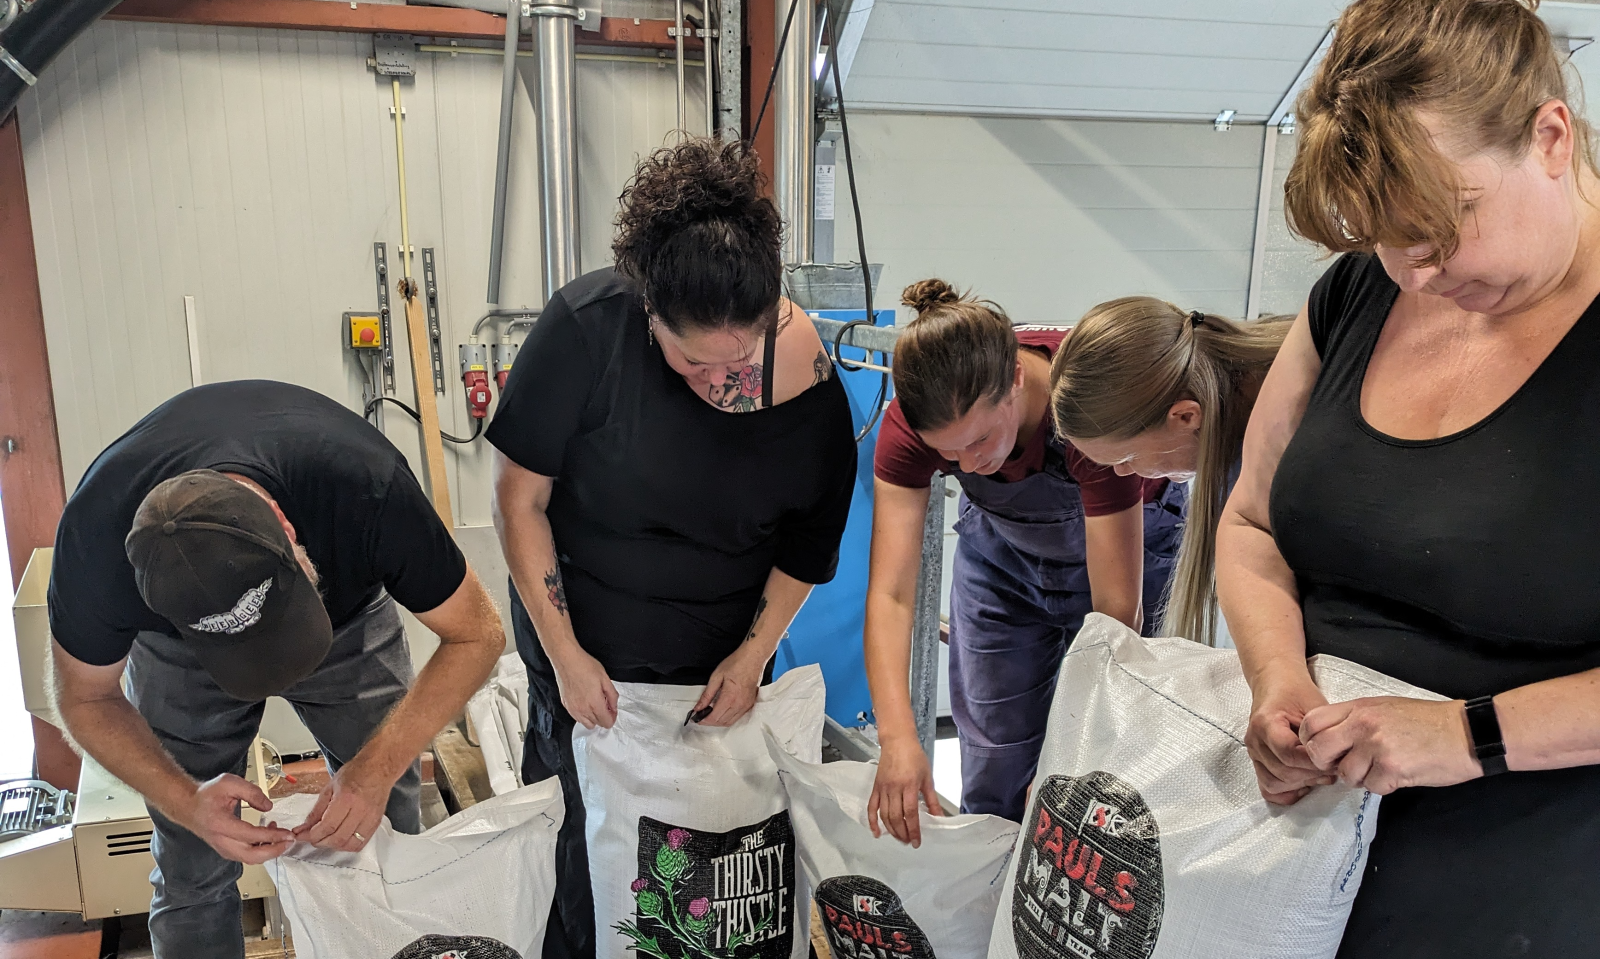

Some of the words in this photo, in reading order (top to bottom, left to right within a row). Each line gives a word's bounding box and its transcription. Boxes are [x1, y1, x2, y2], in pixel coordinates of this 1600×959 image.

[742, 830, 765, 851] THE
[1034, 808, 1139, 914] PAULS
[711, 843, 785, 899] THIRSTY
[1024, 846, 1123, 949] MALT
[713, 887, 787, 949] THISTLE
[825, 905, 913, 953] PAULS
